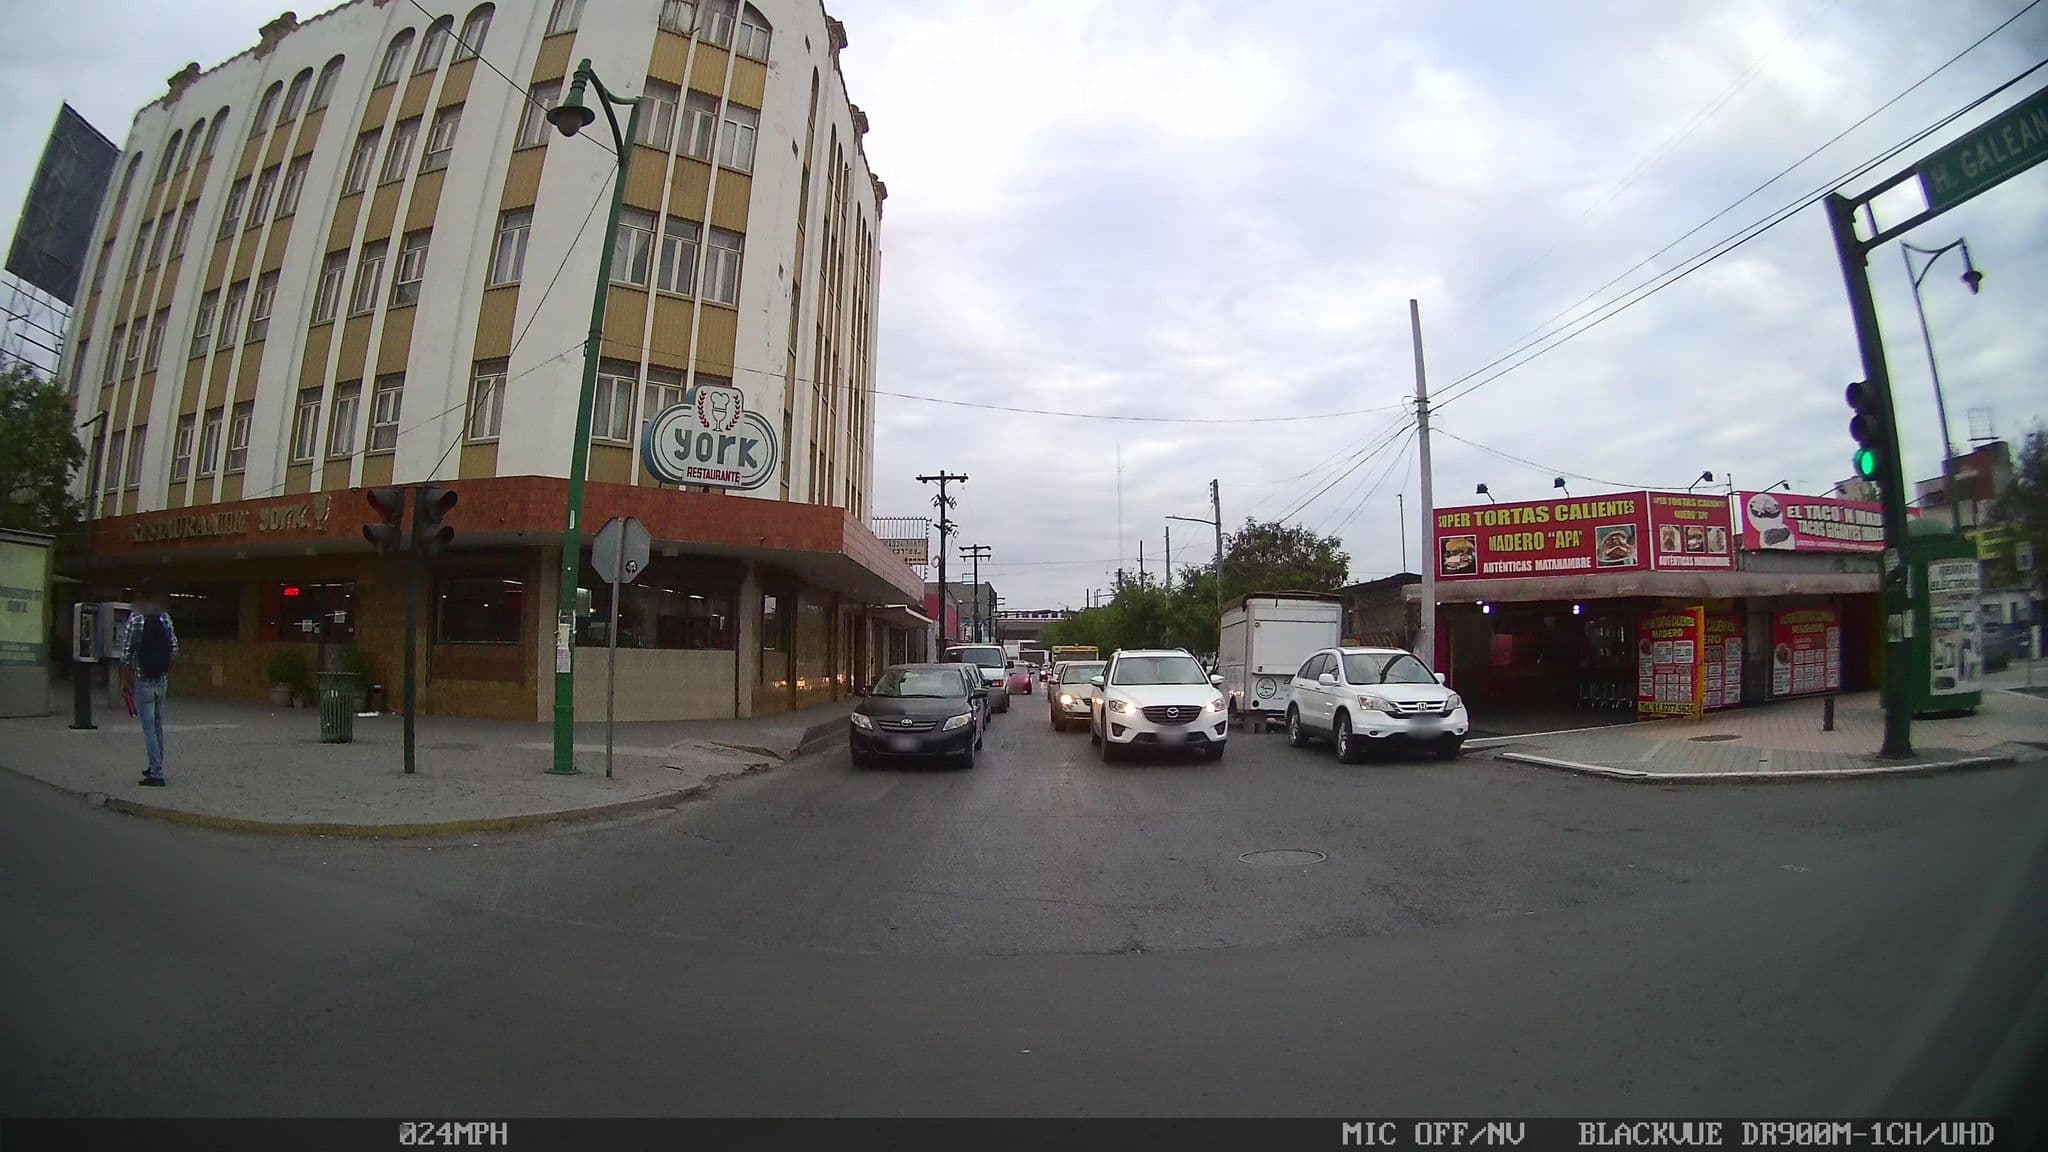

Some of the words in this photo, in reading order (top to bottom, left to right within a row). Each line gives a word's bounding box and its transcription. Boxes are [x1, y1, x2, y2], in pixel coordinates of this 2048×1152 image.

[686, 466, 741, 483] RESTAURANTE
[1438, 512, 1471, 528] SUPER
[1474, 505, 1550, 527] TORTAS
[1554, 500, 1635, 522] CALIENTES
[1786, 505, 1803, 519] EL
[1488, 532, 1545, 552] MADERO
